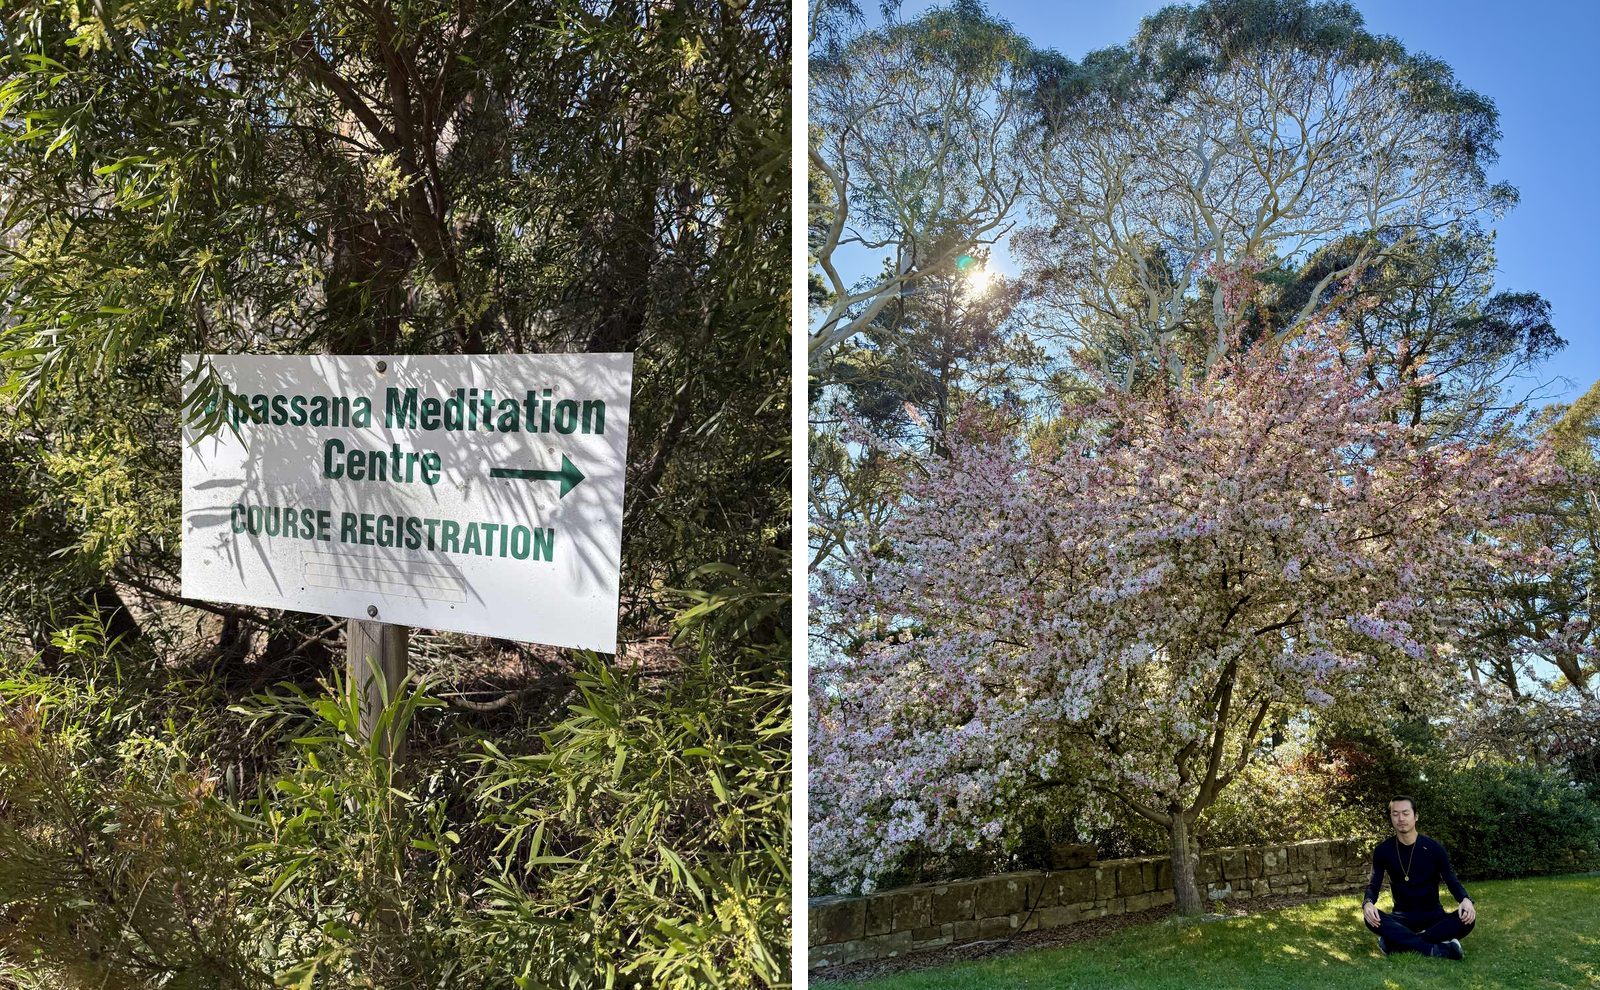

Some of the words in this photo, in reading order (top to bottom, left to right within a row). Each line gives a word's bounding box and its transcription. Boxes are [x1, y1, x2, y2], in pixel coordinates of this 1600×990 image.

[385, 387, 606, 435] Meditation
[323, 438, 442, 486] Centre
[231, 503, 331, 542] COURSE
[340, 514, 556, 563] REGISTRATION
